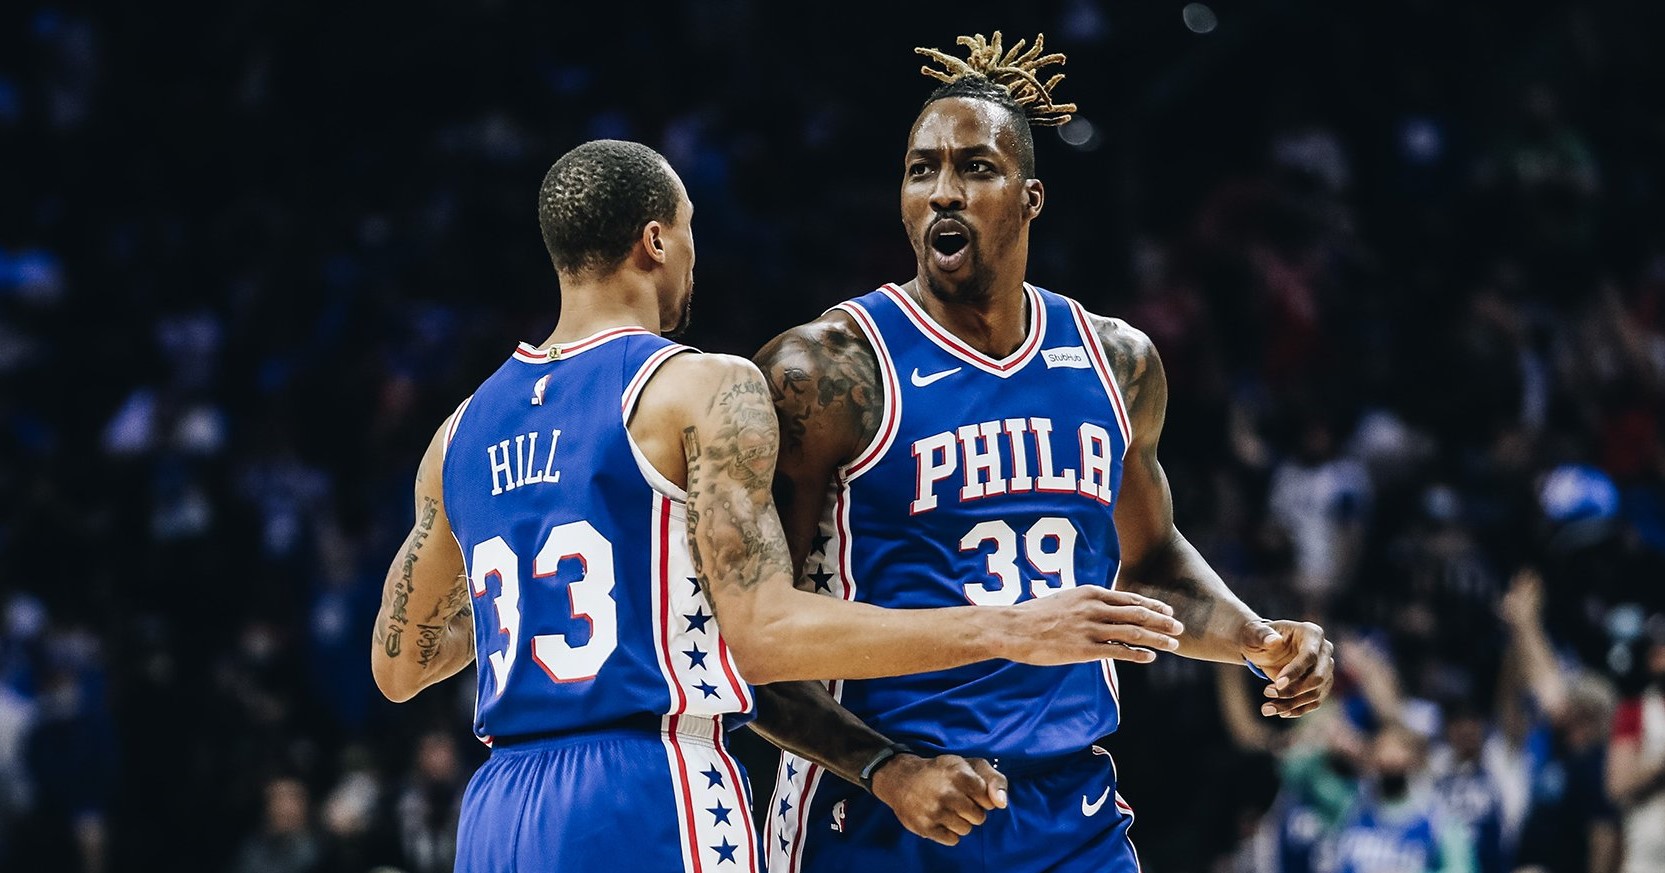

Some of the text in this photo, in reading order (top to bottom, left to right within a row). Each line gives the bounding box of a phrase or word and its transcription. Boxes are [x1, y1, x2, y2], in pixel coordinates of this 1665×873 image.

[1048, 353, 1082, 362] StubHub
[488, 429, 561, 496] HILL
[910, 417, 1112, 515] PHILA
[959, 517, 1078, 606] 39
[470, 520, 618, 698] 33
